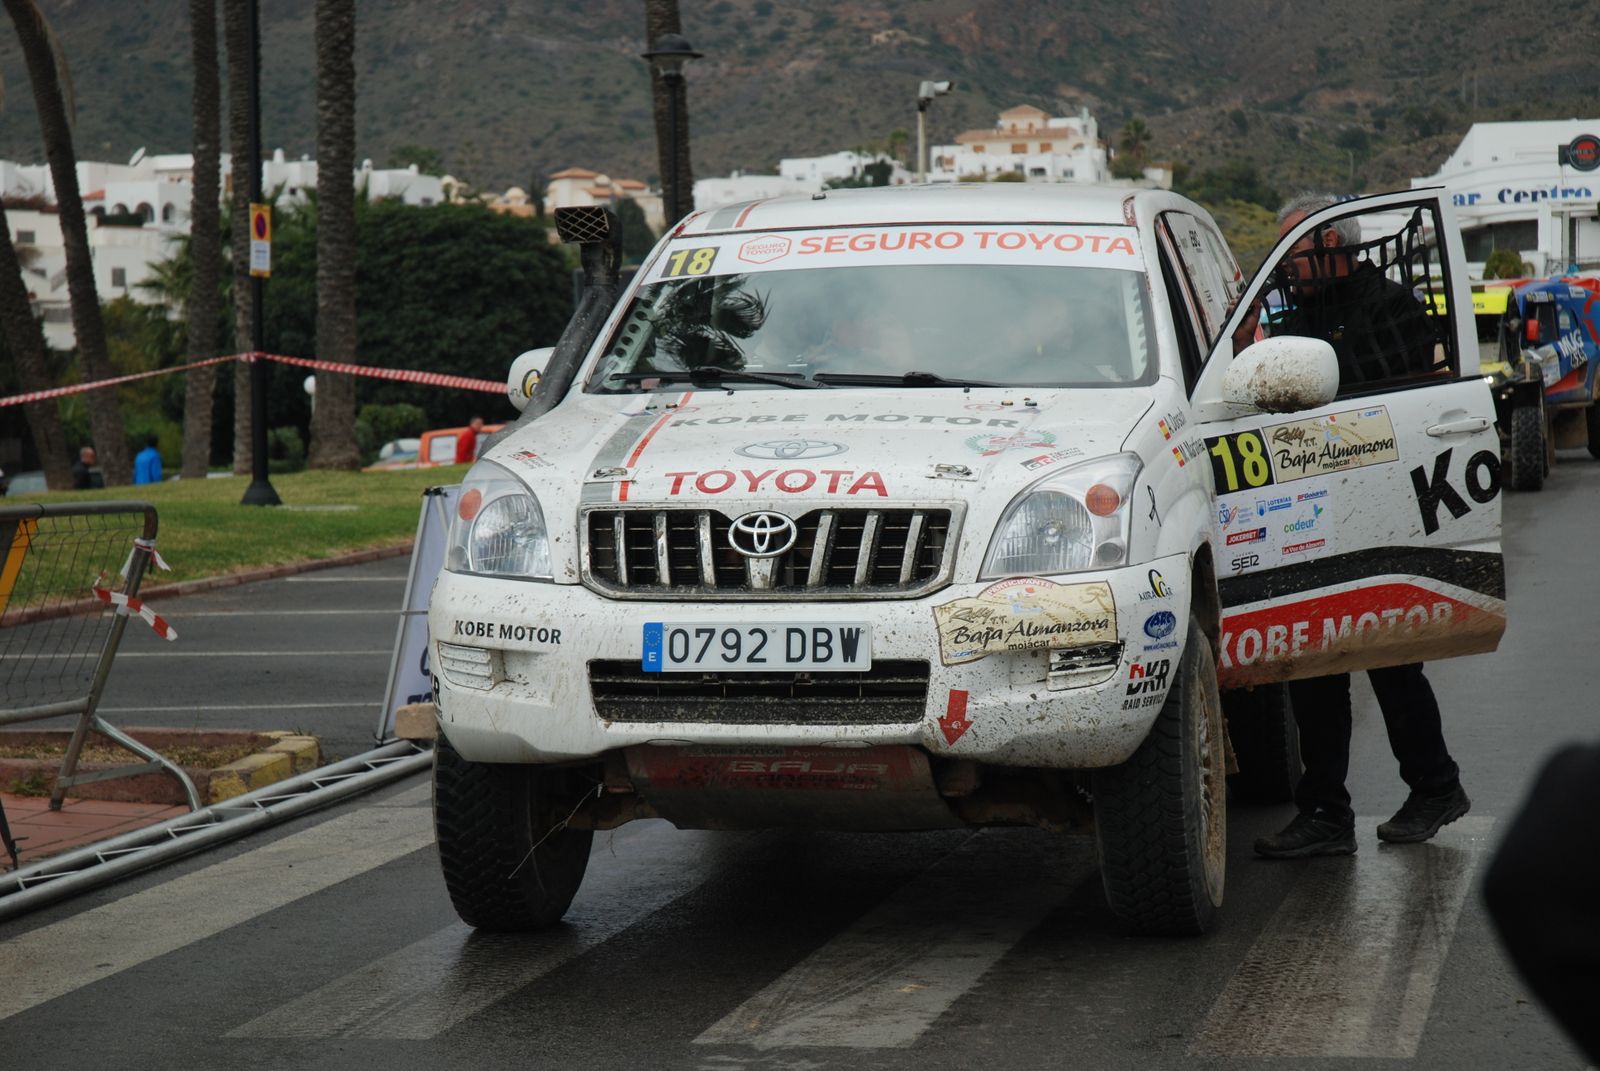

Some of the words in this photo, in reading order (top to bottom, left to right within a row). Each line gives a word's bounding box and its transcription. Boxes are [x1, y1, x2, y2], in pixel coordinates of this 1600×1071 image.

[797, 231, 965, 255] SEGURO
[973, 231, 1136, 256] TOYOTA
[669, 247, 716, 277] 18
[670, 414, 809, 427] KOBE
[823, 414, 1019, 428] MOTOR
[1210, 432, 1269, 491] 18
[1274, 448, 1316, 473] Baja
[1317, 438, 1395, 467] Almanzora
[665, 469, 889, 498] TOYOTA
[1284, 518, 1315, 533] codeur
[454, 620, 494, 638] KOBE
[500, 624, 562, 645] MOTOR
[668, 628, 769, 664] 0792
[785, 627, 861, 663] DBW
[951, 625, 1003, 648] Baja
[1005, 618, 1109, 643] Almanzora
[1008, 639, 1050, 651] mojácar
[1217, 621, 1310, 669] KOBE
[648, 652, 657, 662] E
[1126, 659, 1170, 695] DKR
[1122, 698, 1141, 710] RAID
[727, 760, 889, 775] BAJA
